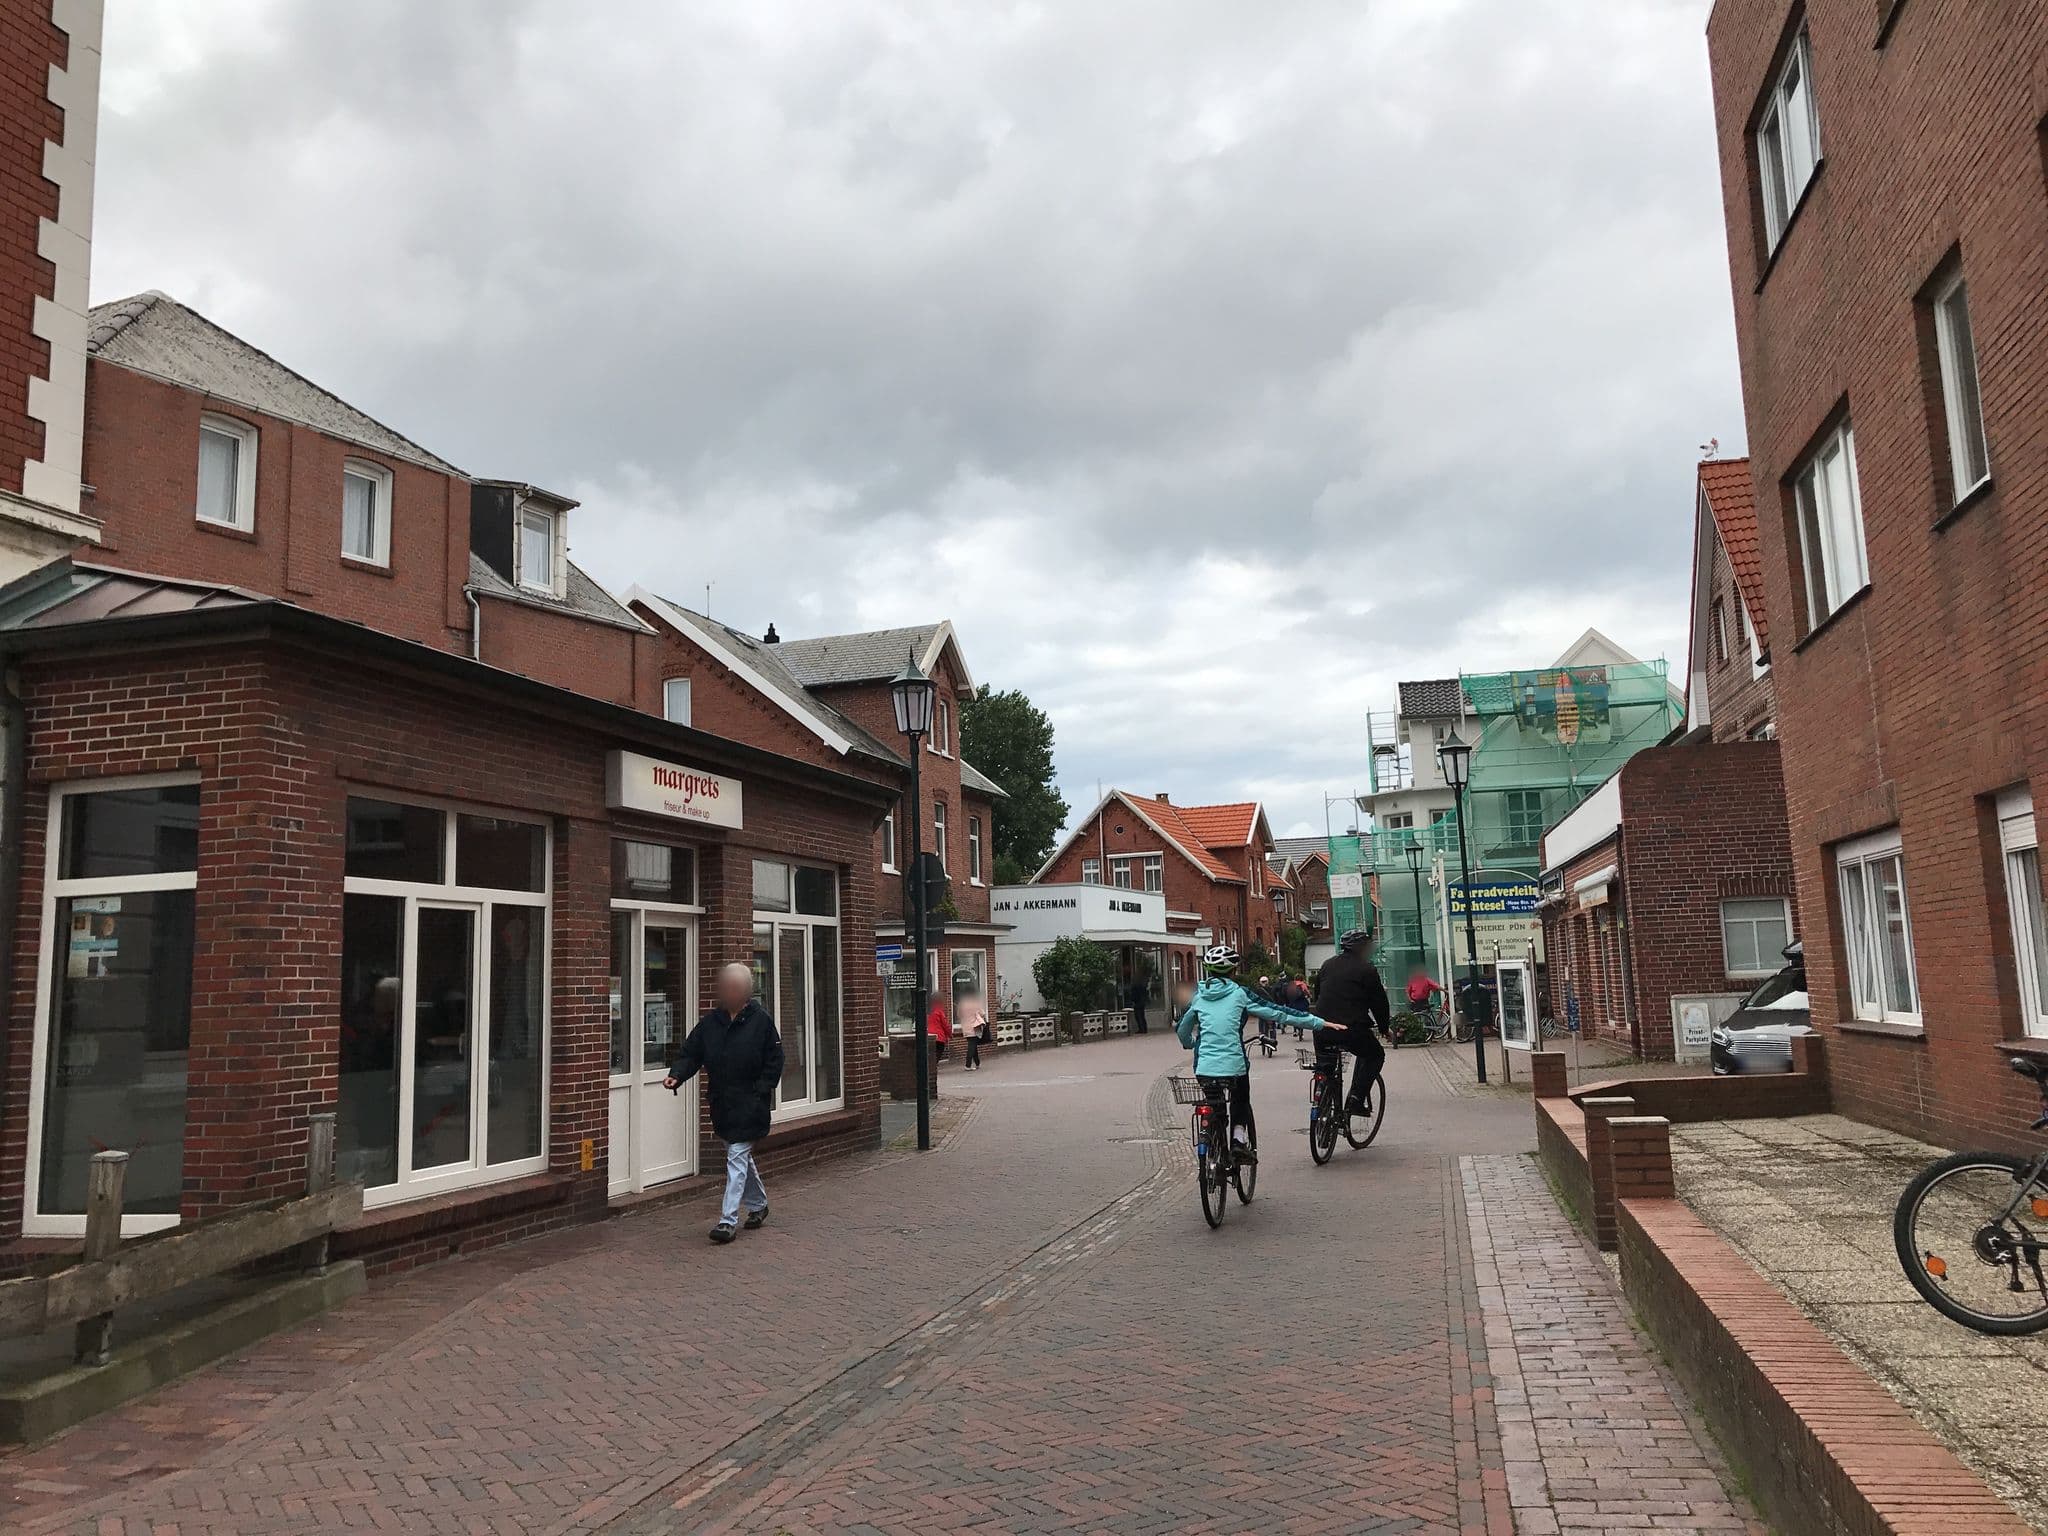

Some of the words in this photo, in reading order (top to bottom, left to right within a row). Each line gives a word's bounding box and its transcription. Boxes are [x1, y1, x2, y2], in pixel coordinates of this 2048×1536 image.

[652, 766, 719, 803] margrets
[664, 800, 682, 812] friseur
[682, 804, 687, 814] &
[702, 810, 710, 820] up
[1450, 885, 1538, 898] Farradverleih
[994, 901, 1010, 911] JAN
[1024, 899, 1076, 910] AKKERMANN
[1451, 900, 1505, 912] Drhtesel
